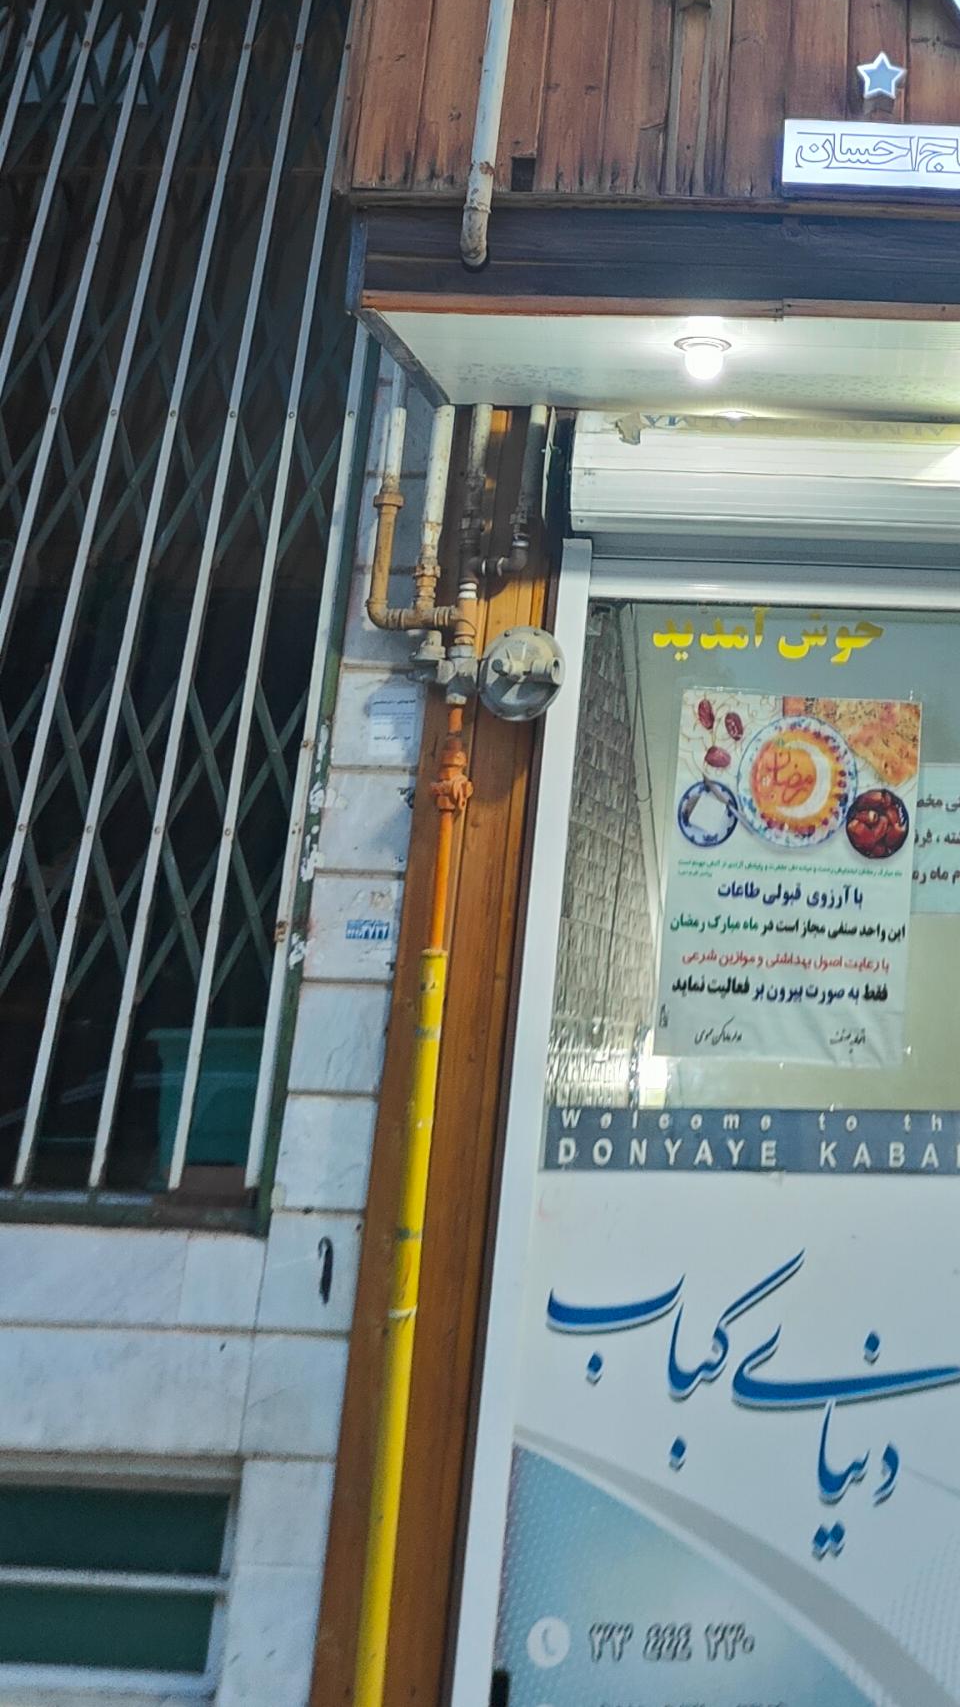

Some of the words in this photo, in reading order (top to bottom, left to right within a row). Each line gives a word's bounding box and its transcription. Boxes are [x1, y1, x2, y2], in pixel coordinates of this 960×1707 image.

[795, 132, 917, 171] احسان
[652, 606, 770, 662] آمدید
[778, 612, 886, 666] خوش
[930, 866, 949, 880] ماه
[717, 879, 761, 899] طاعات
[762, 882, 801, 907] قبولی
[806, 884, 852, 910] آرزوی
[854, 888, 864, 910] با
[669, 912, 706, 933] رمضان
[707, 912, 741, 934] مبارک
[742, 915, 759, 931] ماه
[775, 916, 799, 933] است
[800, 918, 826, 939] مجاز
[828, 921, 858, 940] صنفی
[860, 921, 886, 942] واحد
[887, 923, 906, 943] این
[682, 948, 717, 965] شرعی
[718, 951, 755, 968] موازین
[765, 952, 812, 971] بهداشتی
[814, 955, 842, 971] اصول
[844, 957, 880, 975] رعایت
[881, 960, 890, 974] با
[671, 974, 706, 998] نماید
[706, 976, 750, 998] فعالیت
[752, 980, 765, 1002] بر
[766, 982, 803, 1005] بیرون
[804, 983, 846, 1006] صورت
[847, 984, 860, 1005] به
[863, 981, 889, 1002] فقط
[561, 1108, 772, 1131] Welcome
[818, 1111, 858, 1131] to
[557, 1138, 778, 1167] DONYAYE
[546, 1247, 806, 1472] کباب
